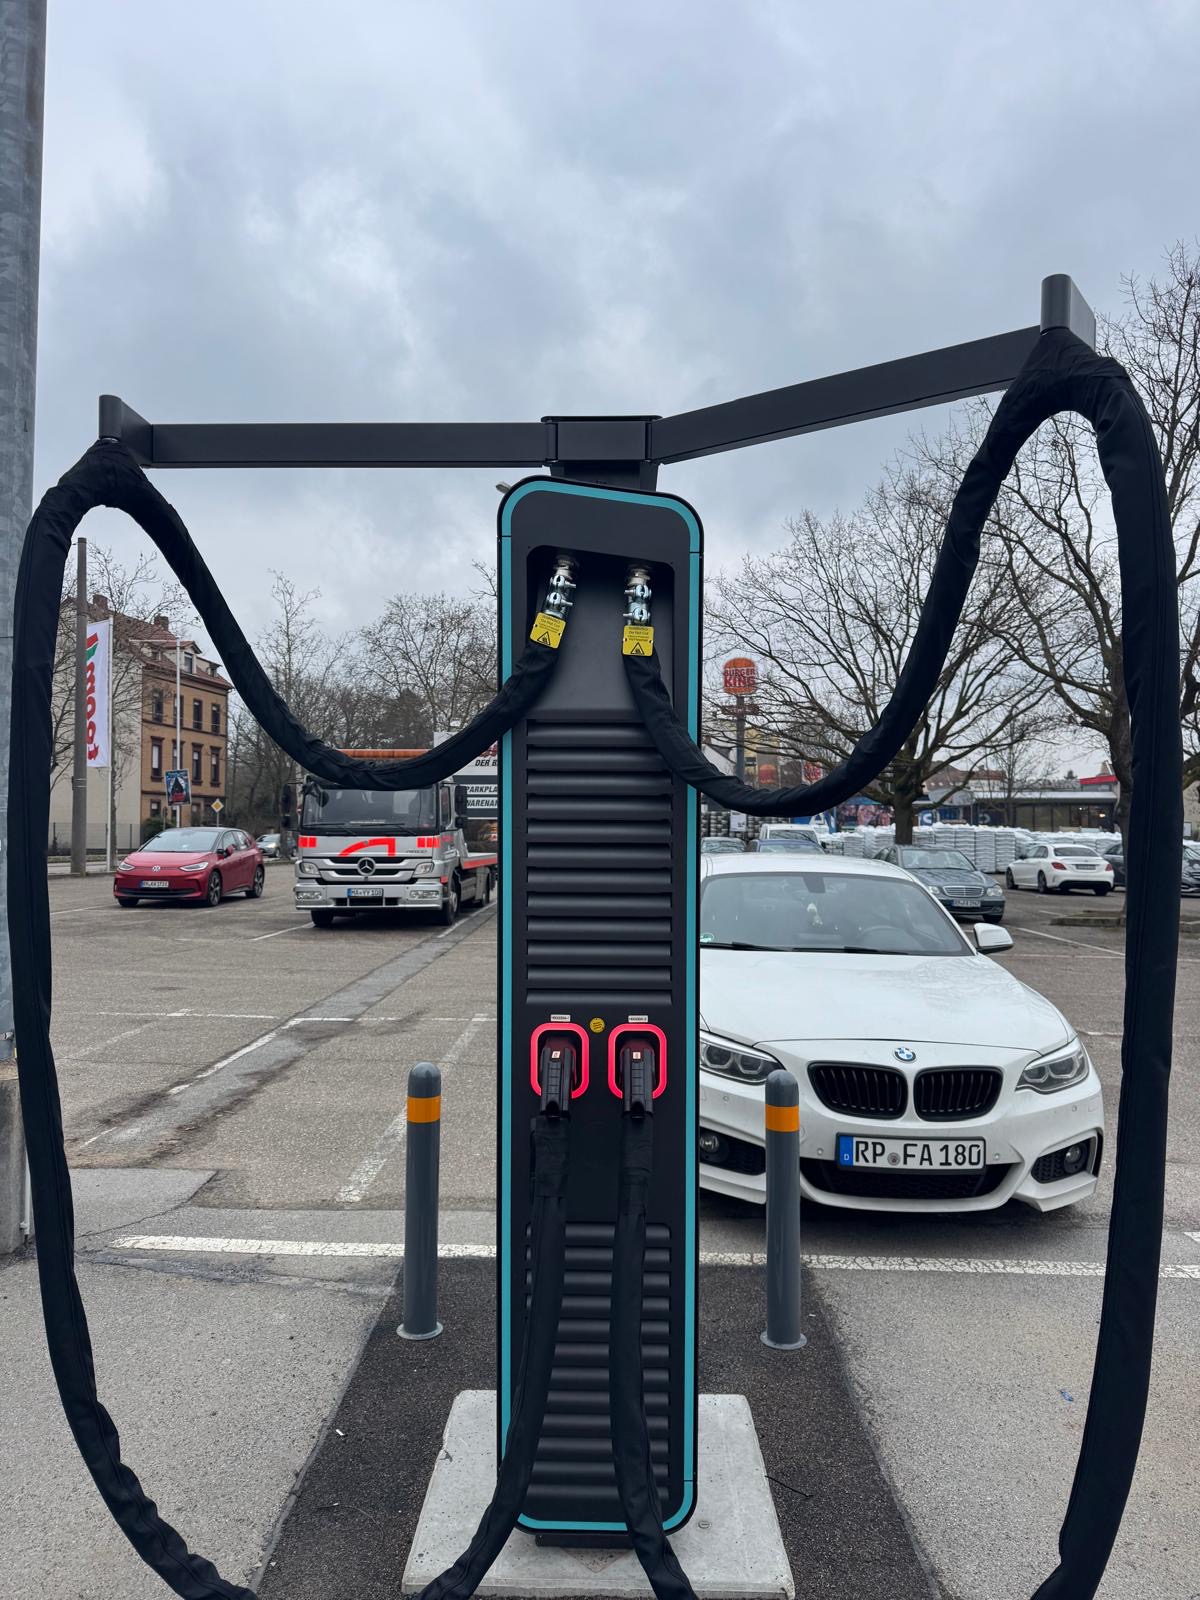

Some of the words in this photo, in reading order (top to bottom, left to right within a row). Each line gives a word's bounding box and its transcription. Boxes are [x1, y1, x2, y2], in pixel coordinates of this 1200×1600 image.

[723, 668, 756, 676] BURGER
[723, 676, 756, 688] KING
[475, 759, 490, 767] DER
[855, 1140, 886, 1164] RP
[903, 1143, 933, 1166] FA
[939, 1144, 981, 1167] 180
